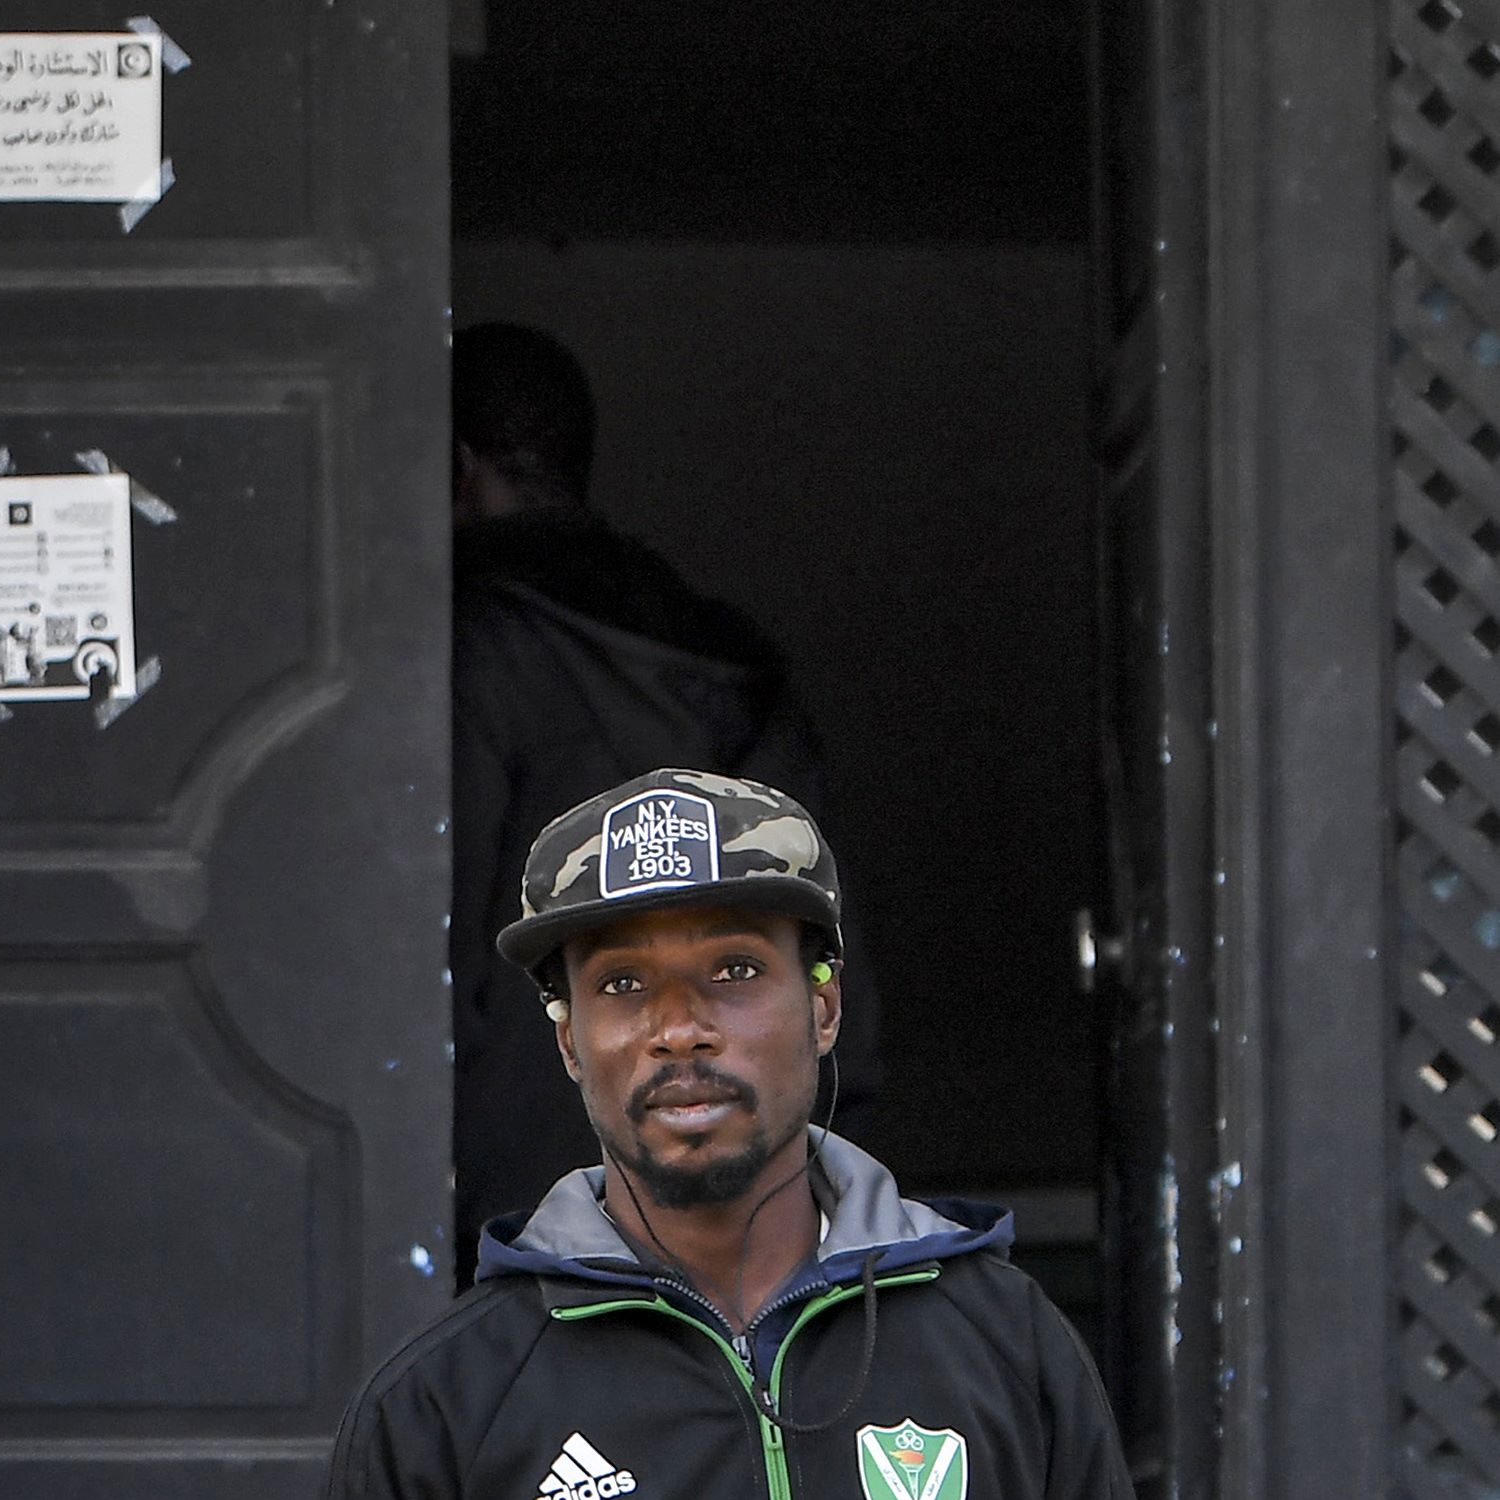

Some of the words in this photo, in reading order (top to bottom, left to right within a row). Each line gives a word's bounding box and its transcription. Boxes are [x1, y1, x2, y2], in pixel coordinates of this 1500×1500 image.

[638, 800, 678, 824] N.Y.
[610, 818, 709, 850] YANKEES
[636, 838, 680, 860] EST.
[628, 856, 691, 881] 1903
